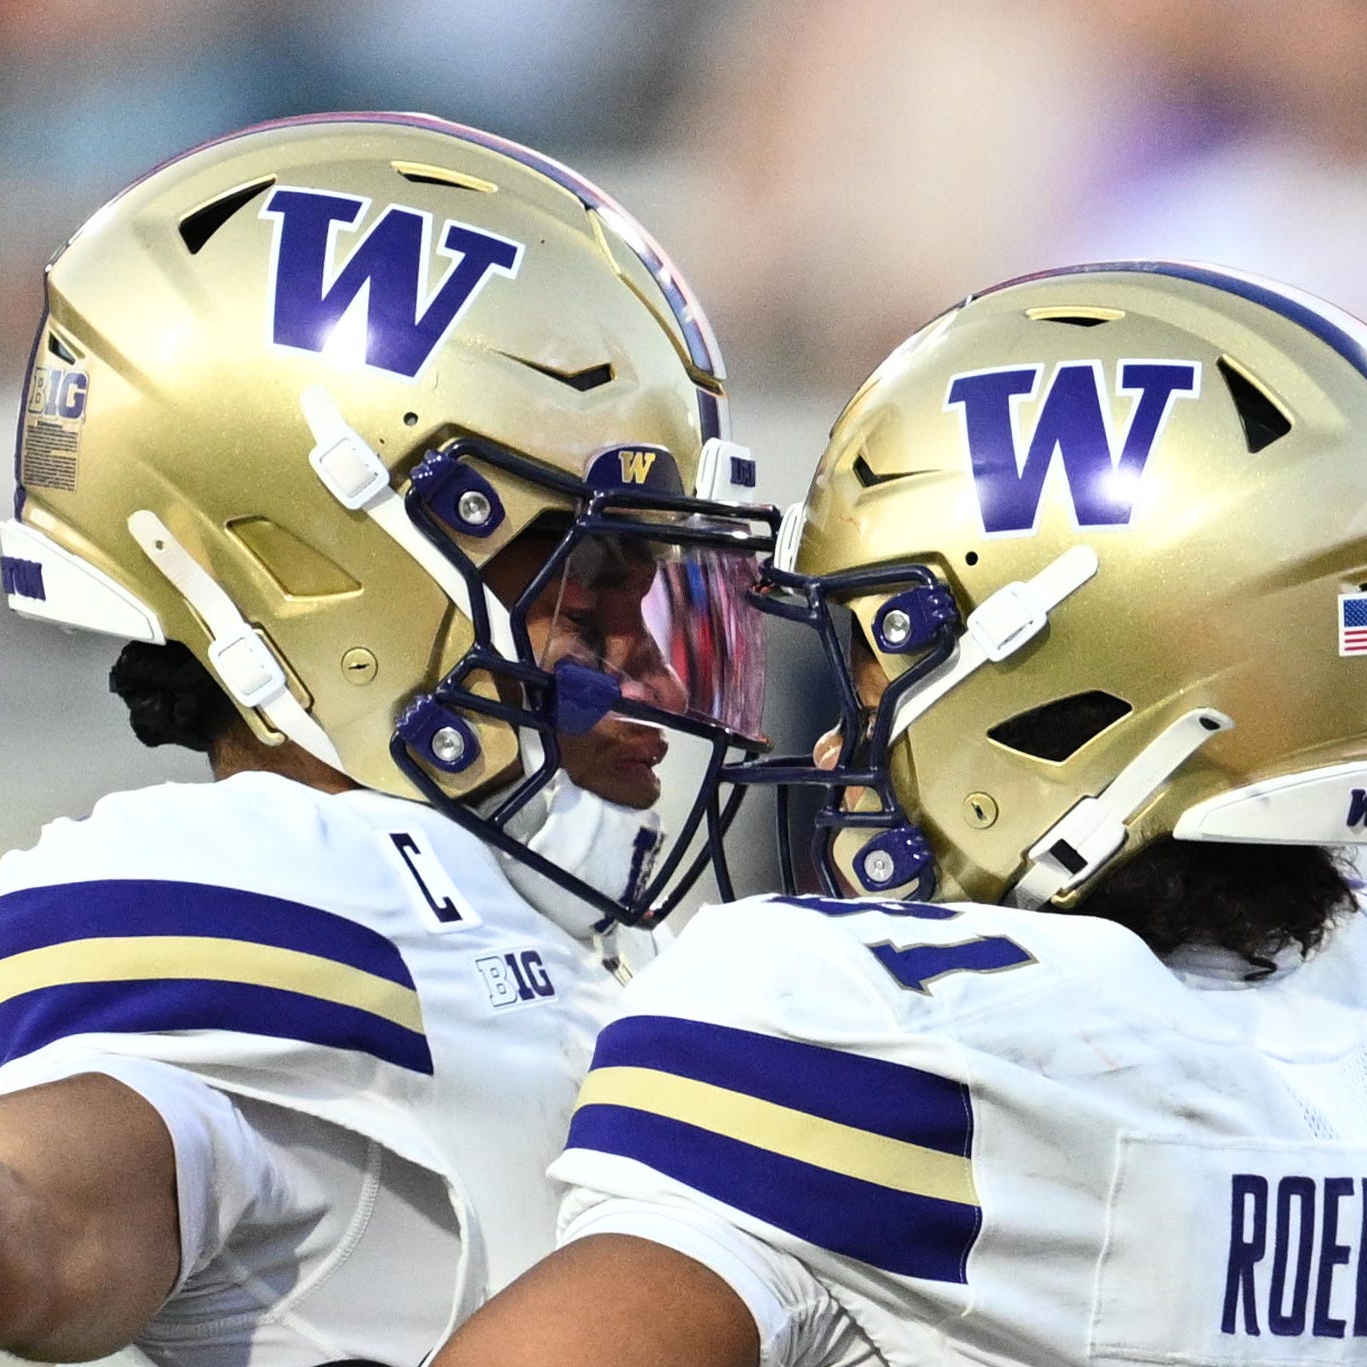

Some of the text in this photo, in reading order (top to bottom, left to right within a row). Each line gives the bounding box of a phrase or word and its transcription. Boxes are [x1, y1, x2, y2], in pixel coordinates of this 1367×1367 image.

[259, 187, 524, 384] W
[618, 451, 656, 484] W
[944, 360, 1201, 540] W
[389, 833, 463, 923] C
[475, 950, 556, 1008] BIG
